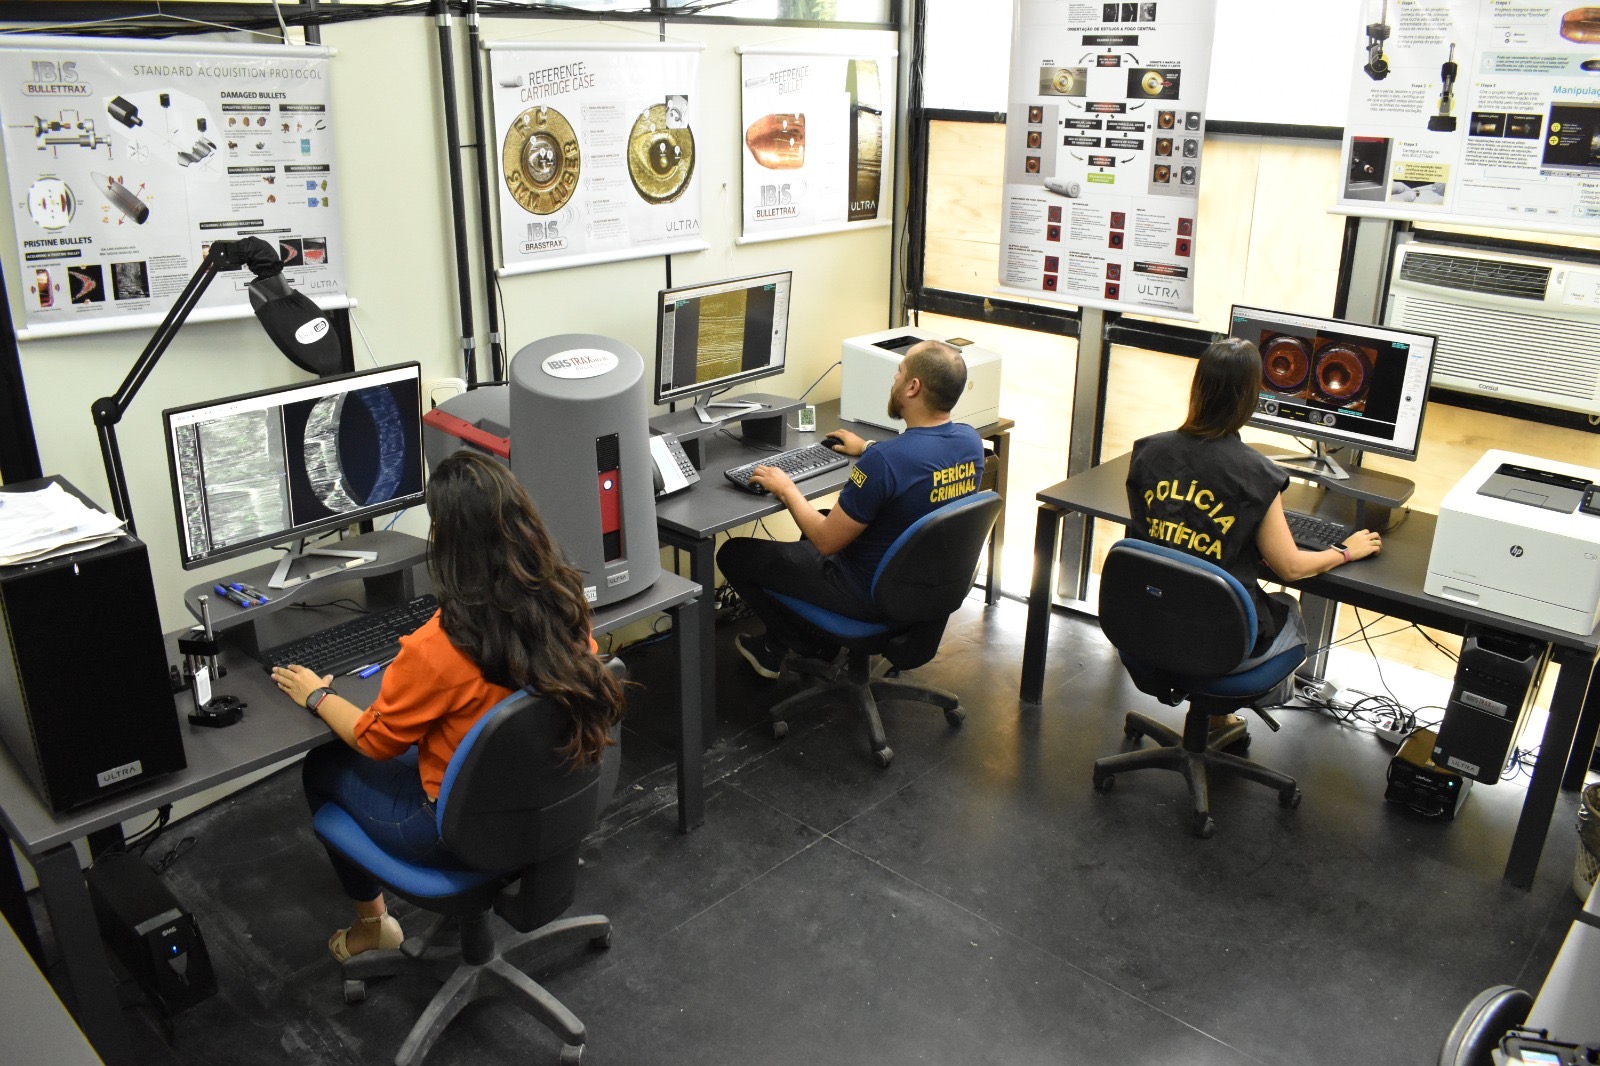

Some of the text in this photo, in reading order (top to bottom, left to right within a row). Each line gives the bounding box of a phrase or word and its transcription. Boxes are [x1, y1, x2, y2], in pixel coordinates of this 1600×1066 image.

[31, 60, 78, 82] IBIS
[133, 66, 322, 80] STANDARD ACQUISITION PROTOCOL
[529, 61, 587, 86] REFERENCE:
[769, 65, 809, 85] REFERENCE
[28, 85, 87, 93] BULLETTRAX
[520, 73, 595, 103] CARTRIDGE CASE
[778, 78, 804, 95] BULLET
[220, 91, 258, 99] DAMAGED
[760, 183, 792, 207] IBIS
[756, 206, 796, 218] BULLETTRAX
[851, 200, 876, 211] ULTRA
[527, 220, 559, 242] IBIS
[666, 219, 700, 232] ULTRA
[23, 236, 93, 248] PRISTINE BULLETS
[525, 240, 563, 251] BRASSTRAX
[311, 279, 339, 289] ULTRA
[1137, 283, 1180, 300] ULTRA
[1478, 382, 1499, 392] Consul
[933, 461, 976, 487] PERÍCIA
[929, 477, 977, 503] CRIMINAL
[1144, 479, 1236, 535] POLÍCIA
[1510, 545, 1524, 558] hp
[609, 573, 627, 585] ULTRA
[1451, 760, 1476, 773] ULTRA
[103, 765, 137, 782] ULTRA
[161, 926, 177, 937] SMS
